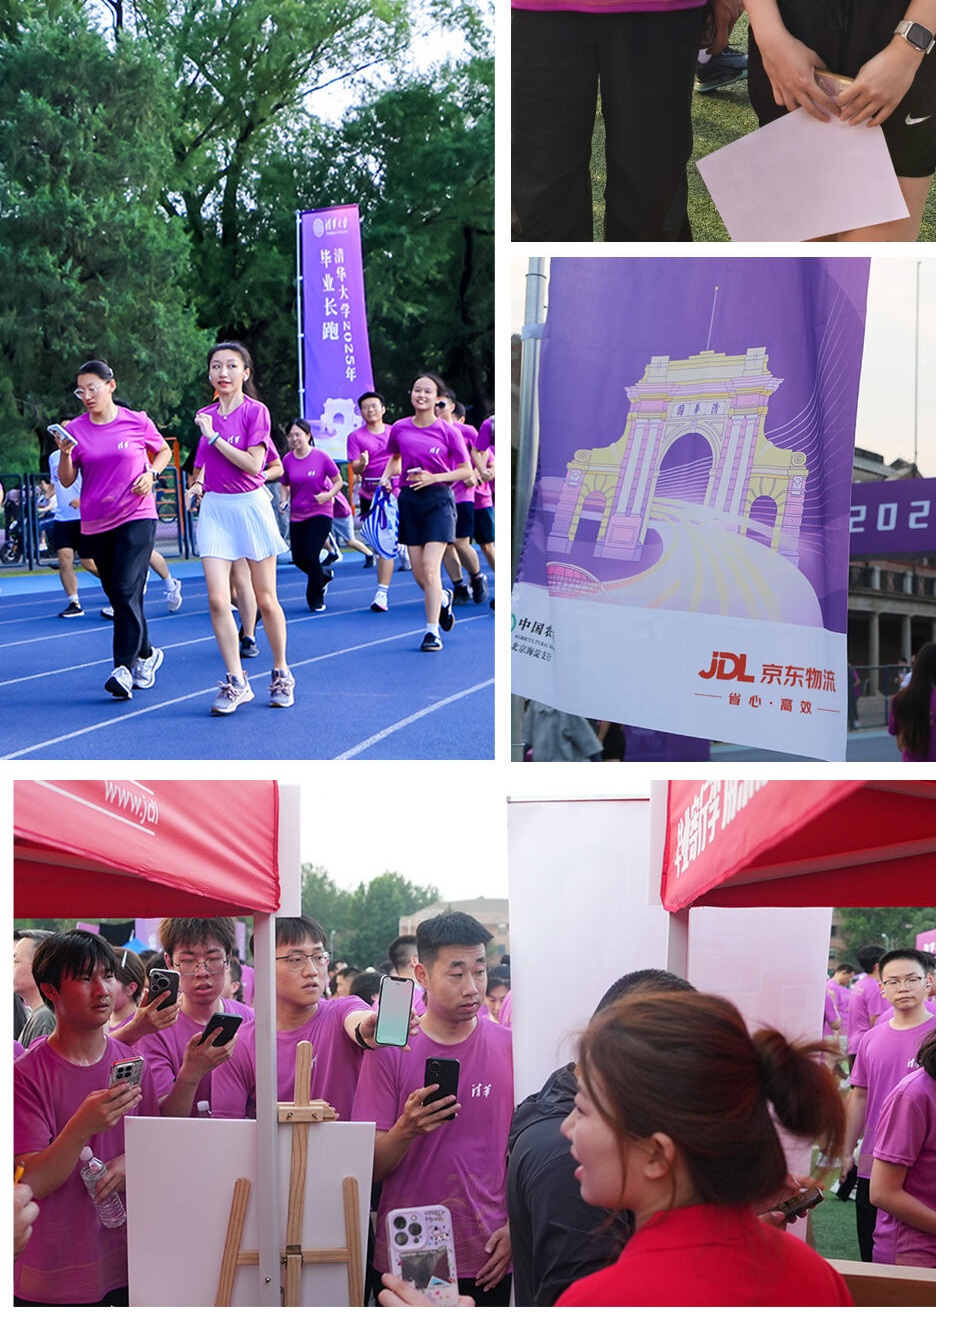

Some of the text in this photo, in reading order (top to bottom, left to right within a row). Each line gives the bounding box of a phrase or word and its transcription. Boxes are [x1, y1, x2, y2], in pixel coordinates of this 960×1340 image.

[320, 248, 339, 341] 毕业长跑
[333, 248, 357, 382] 清华大学2025年
[697, 651, 837, 693] JDL 京东物流
